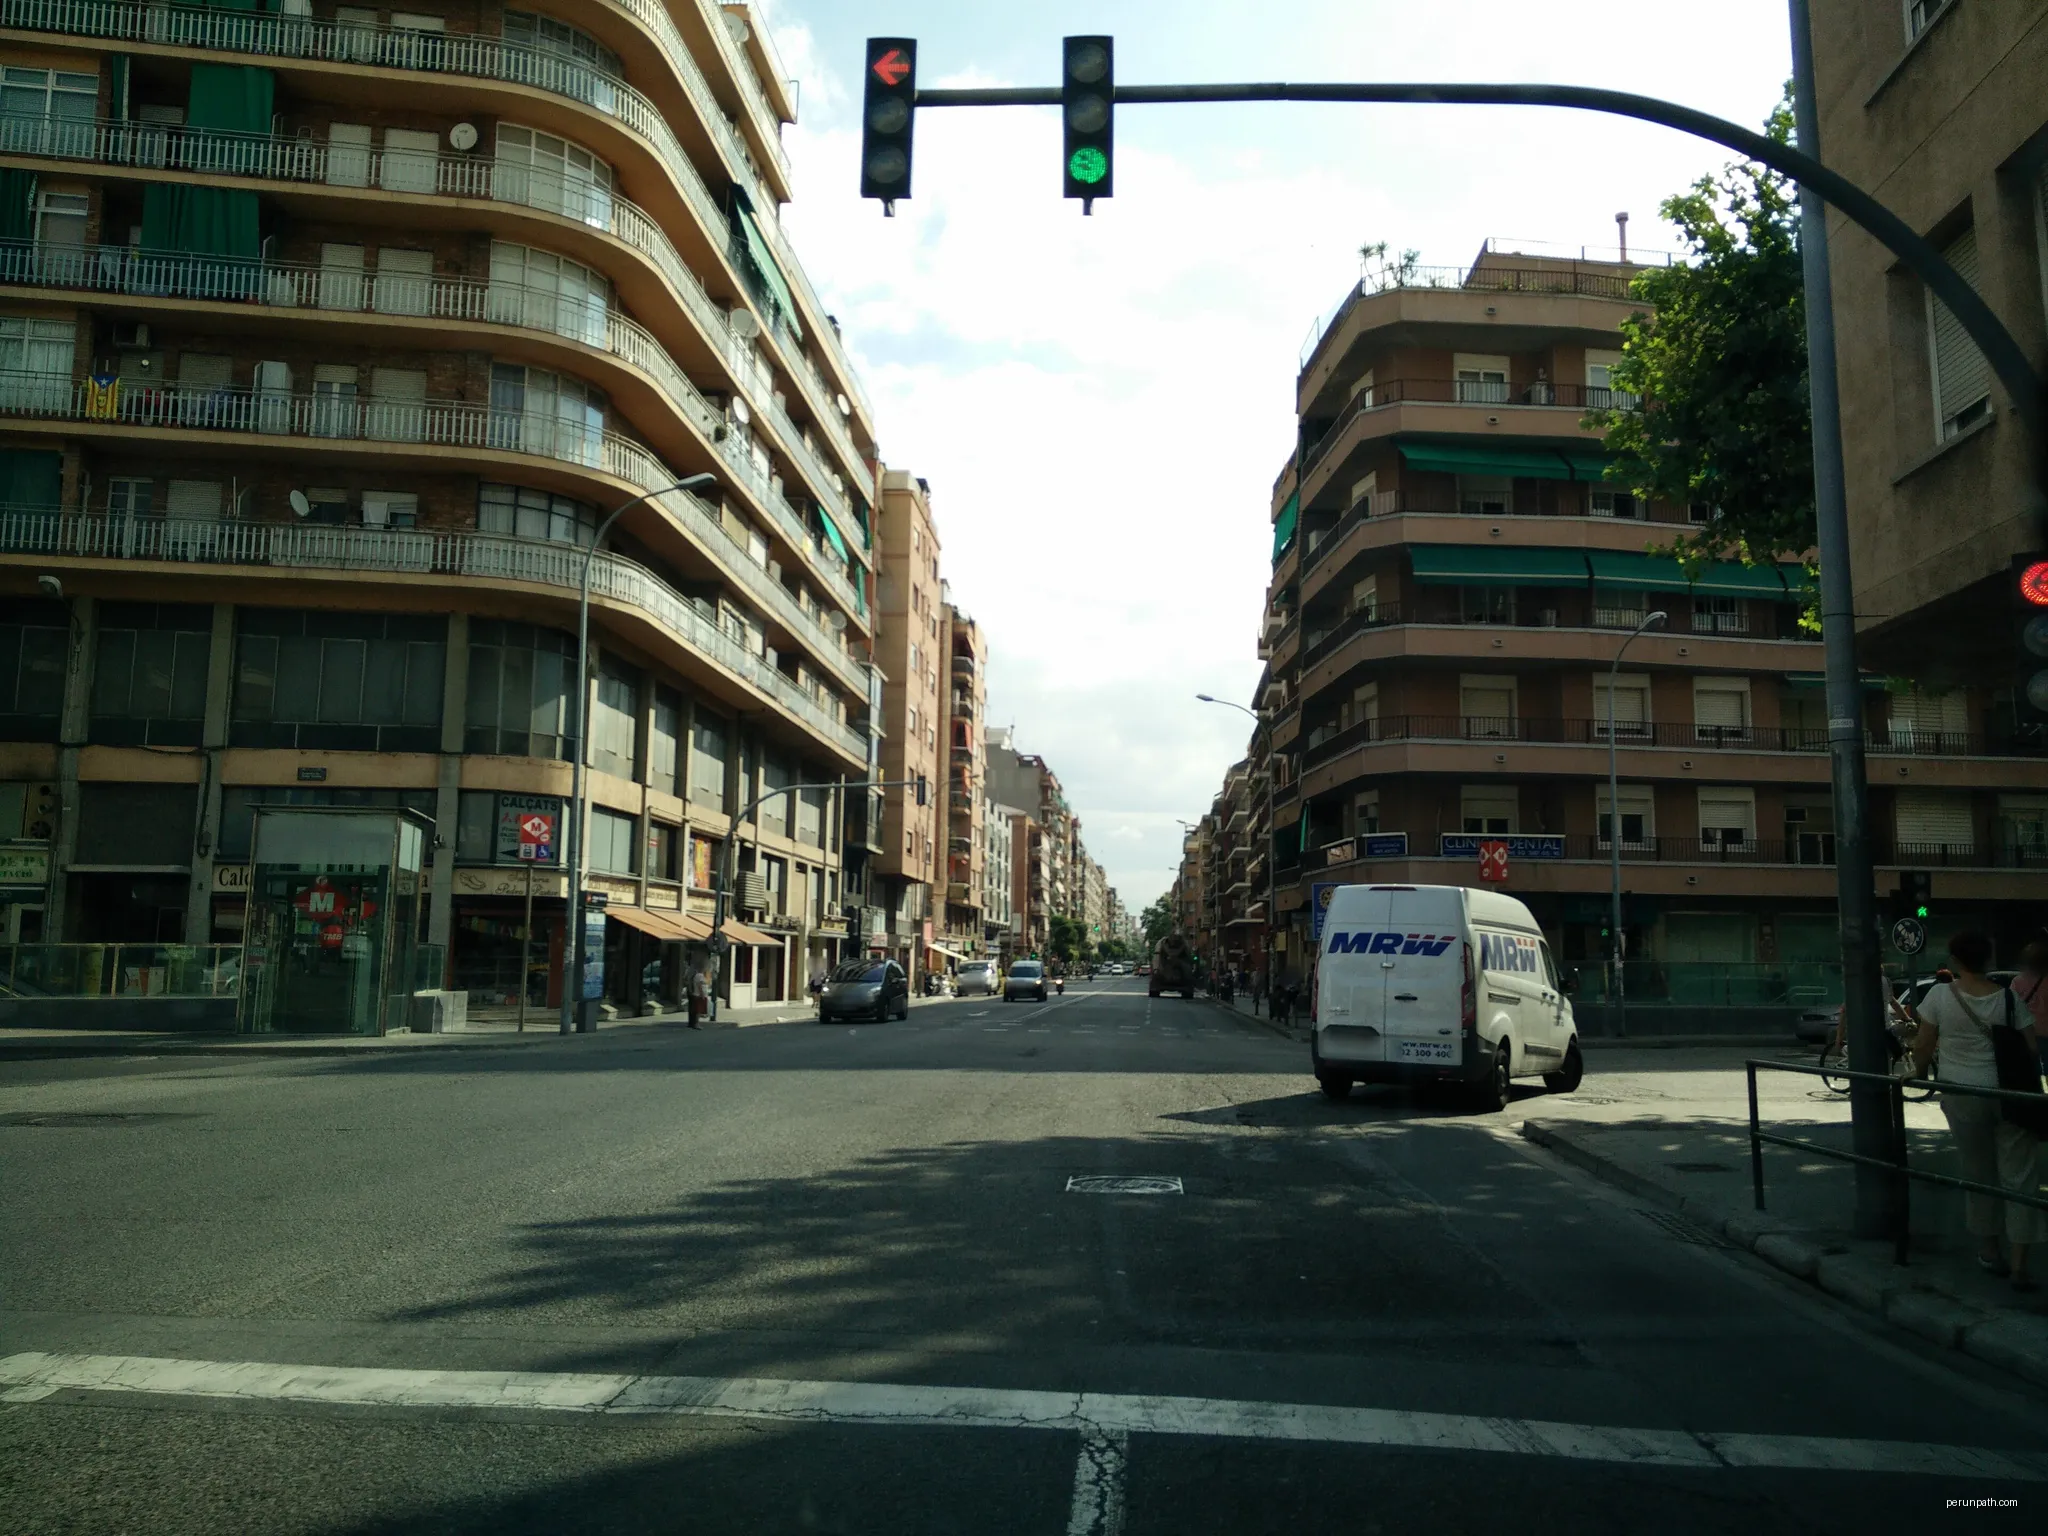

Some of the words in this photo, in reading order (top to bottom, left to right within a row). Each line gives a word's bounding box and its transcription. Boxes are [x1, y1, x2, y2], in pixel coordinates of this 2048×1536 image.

[501, 796, 558, 812] CALÇATS
[531, 822, 542, 832] M
[1508, 838, 1560, 850] DENTAL
[495, 882, 525, 895] Pedro
[532, 883, 560, 896] Pastor
[309, 892, 335, 913] M
[323, 932, 343, 941] TMB
[1328, 932, 1456, 956] MRW
[1480, 933, 1536, 973] MRW
